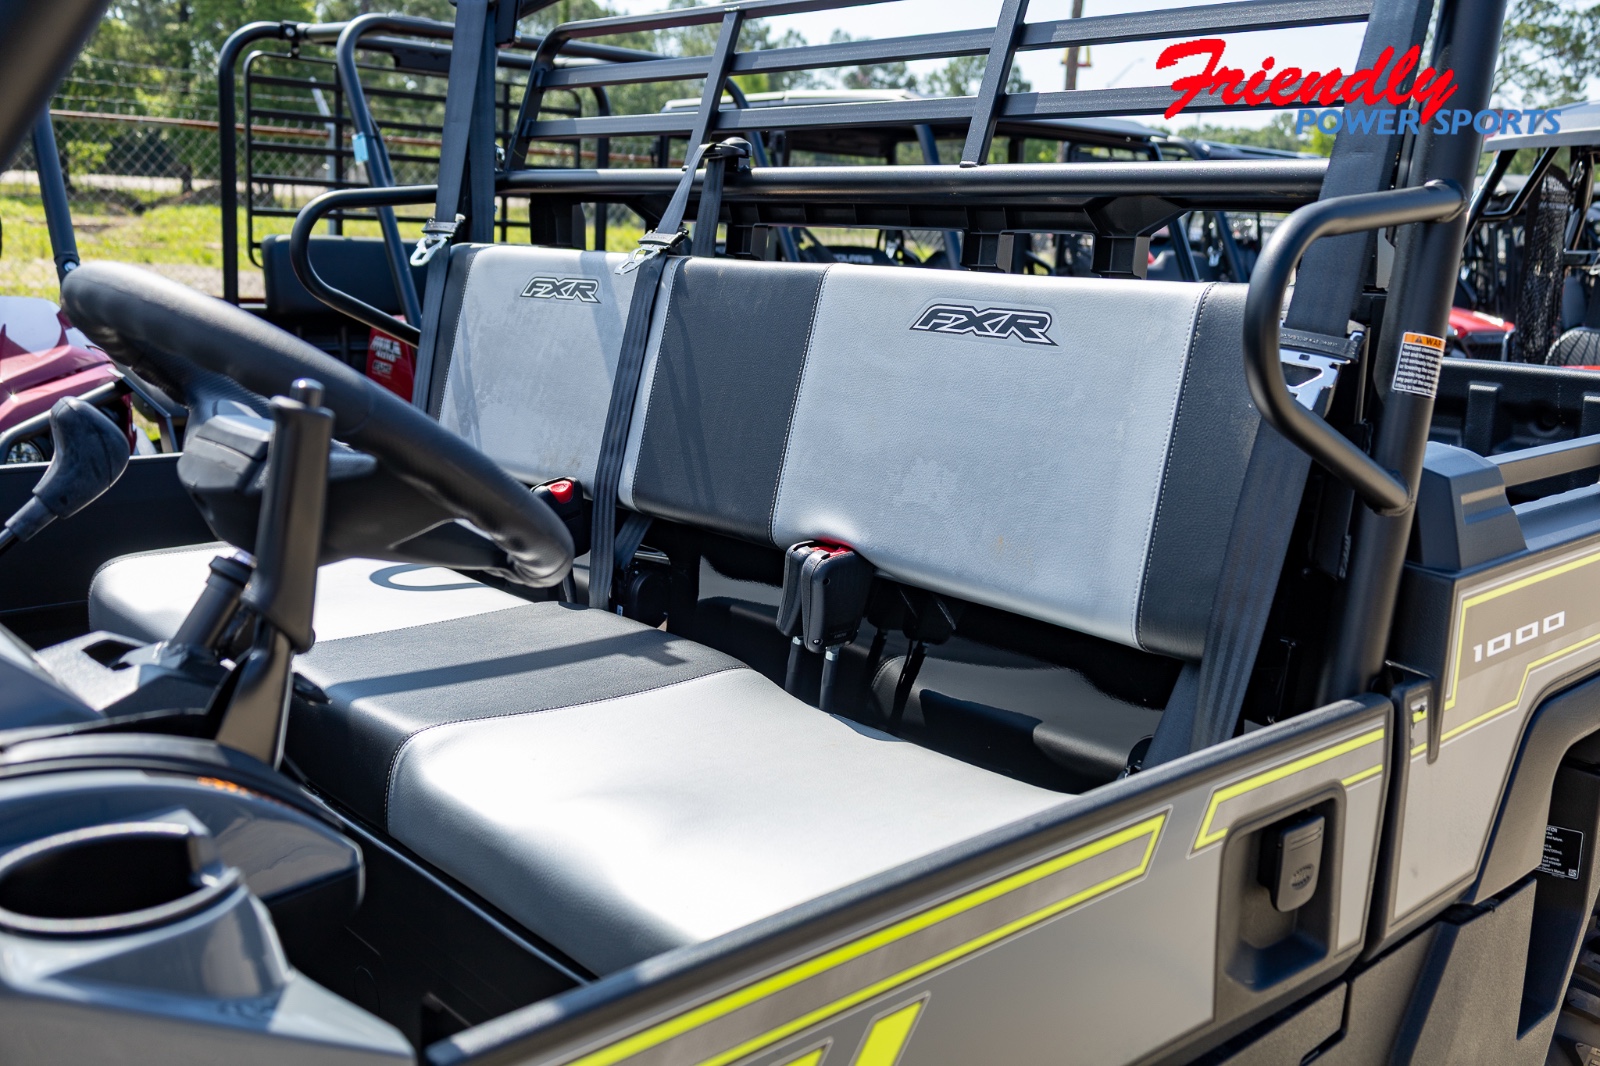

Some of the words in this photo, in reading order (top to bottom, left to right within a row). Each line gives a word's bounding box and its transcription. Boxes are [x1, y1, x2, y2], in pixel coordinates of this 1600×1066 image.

[519, 276, 602, 304] FXR
[909, 303, 1059, 347] FXR
[1473, 610, 1565, 663] 1000
